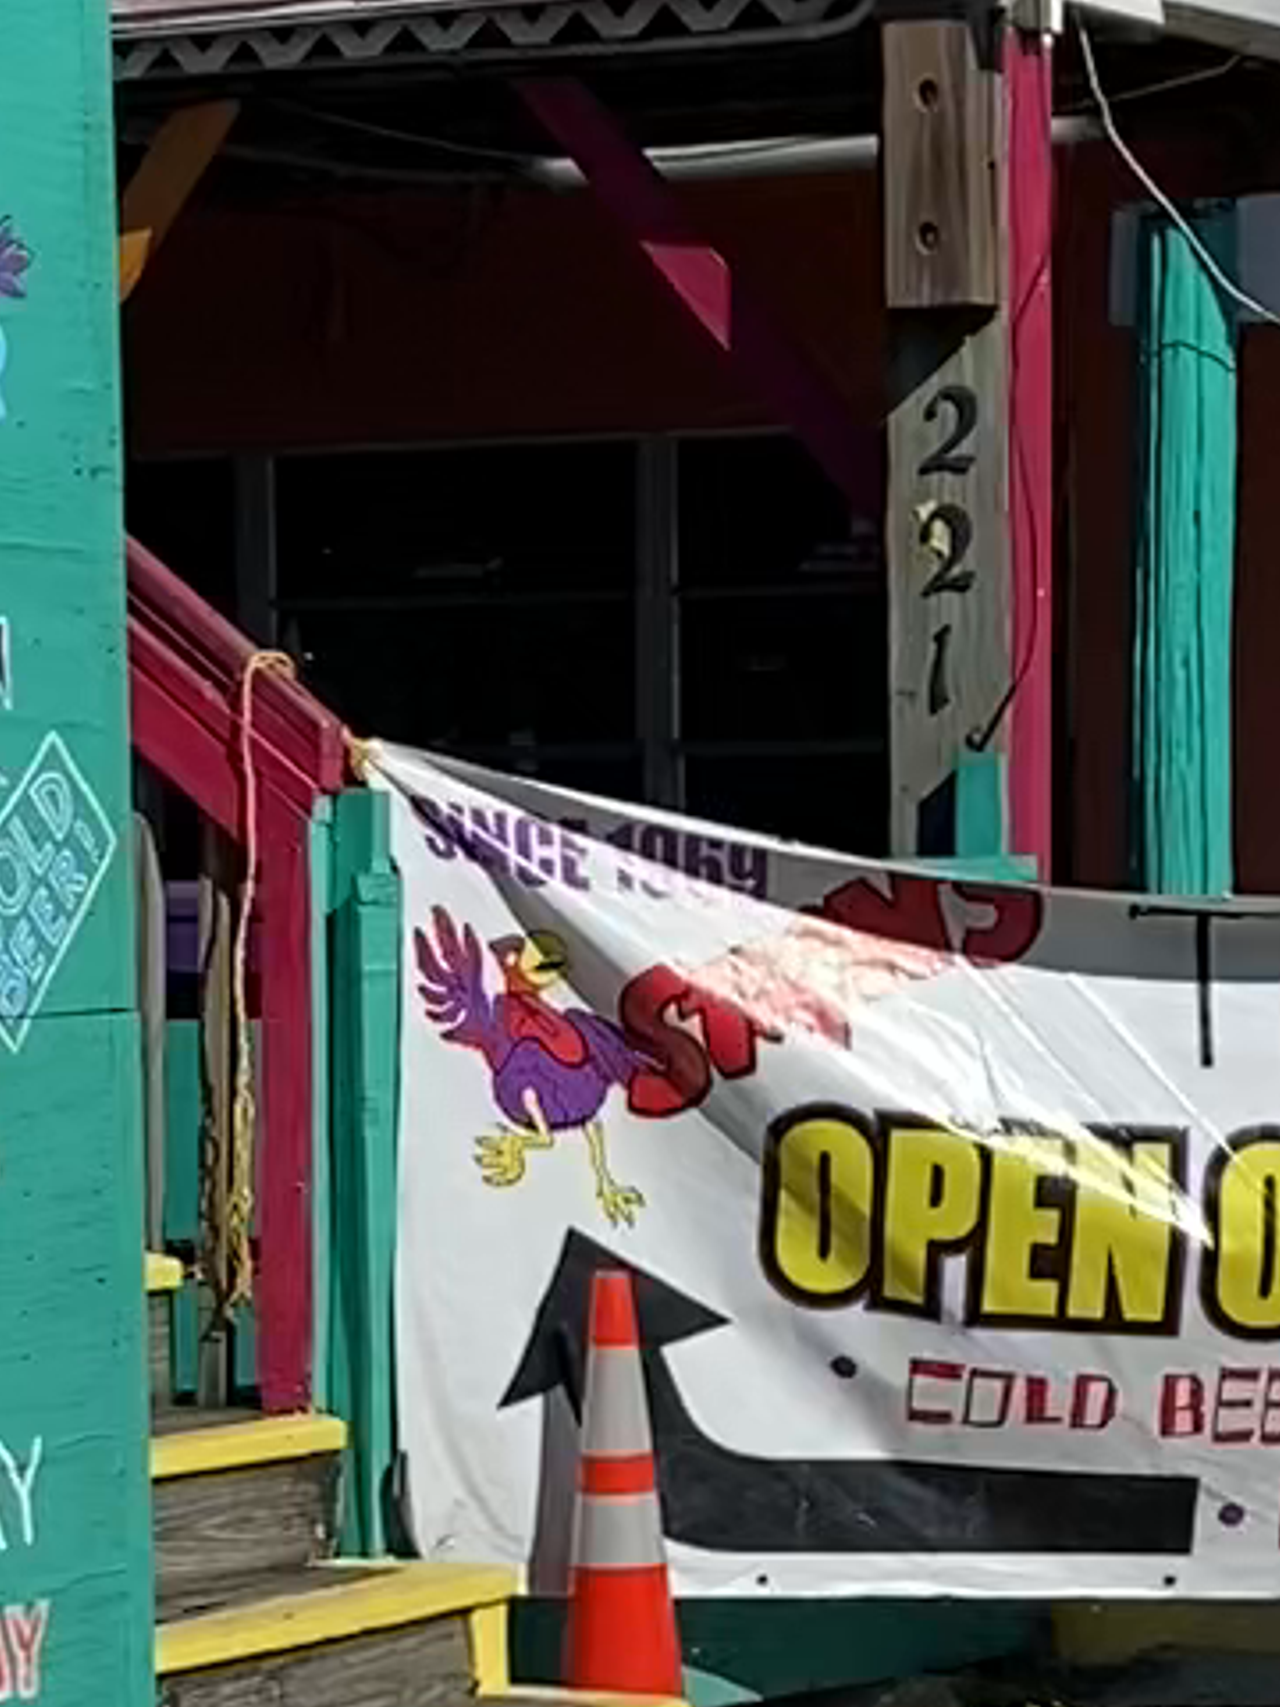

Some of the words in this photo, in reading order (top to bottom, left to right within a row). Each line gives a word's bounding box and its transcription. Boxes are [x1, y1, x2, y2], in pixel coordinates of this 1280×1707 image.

[410, 791, 593, 893] SINCE
[759, 1100, 1186, 1335] OPEN
[905, 1357, 1117, 1433] COLD
